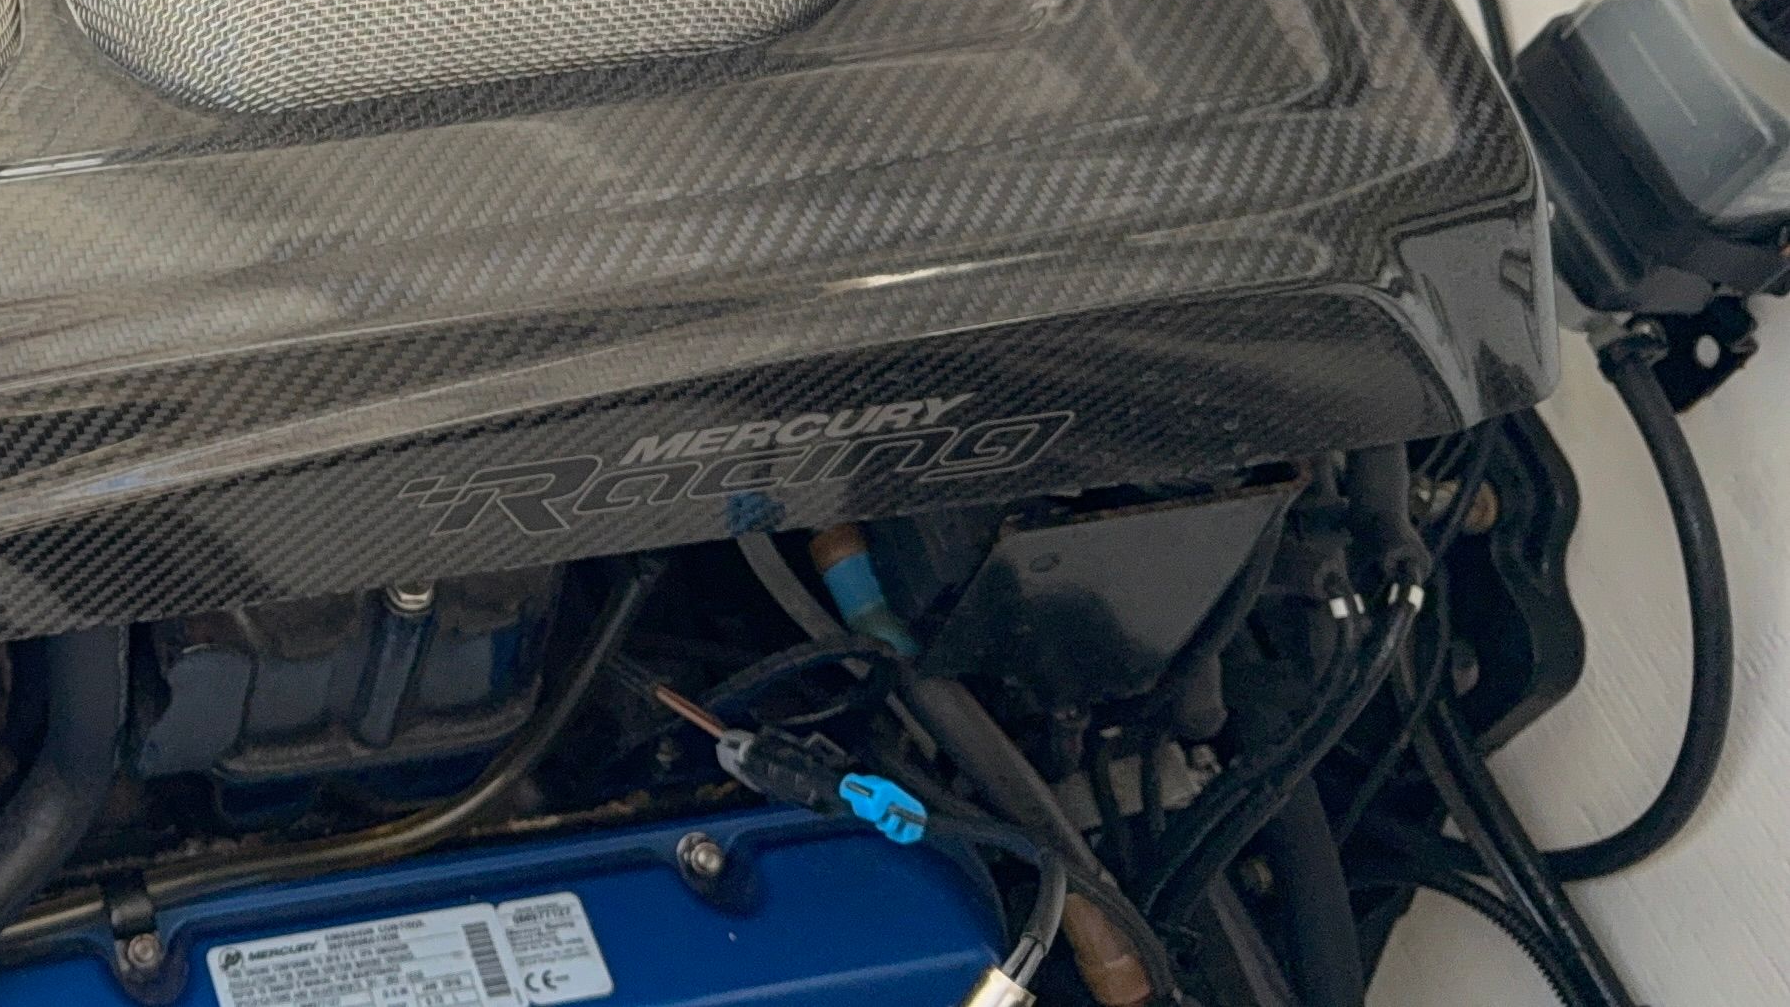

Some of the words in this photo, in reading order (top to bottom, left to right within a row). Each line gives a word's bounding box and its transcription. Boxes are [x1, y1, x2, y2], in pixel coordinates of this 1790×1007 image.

[619, 393, 976, 465] MERCURY
[399, 409, 1076, 536] Racing
[248, 940, 318, 961] MERCURY
